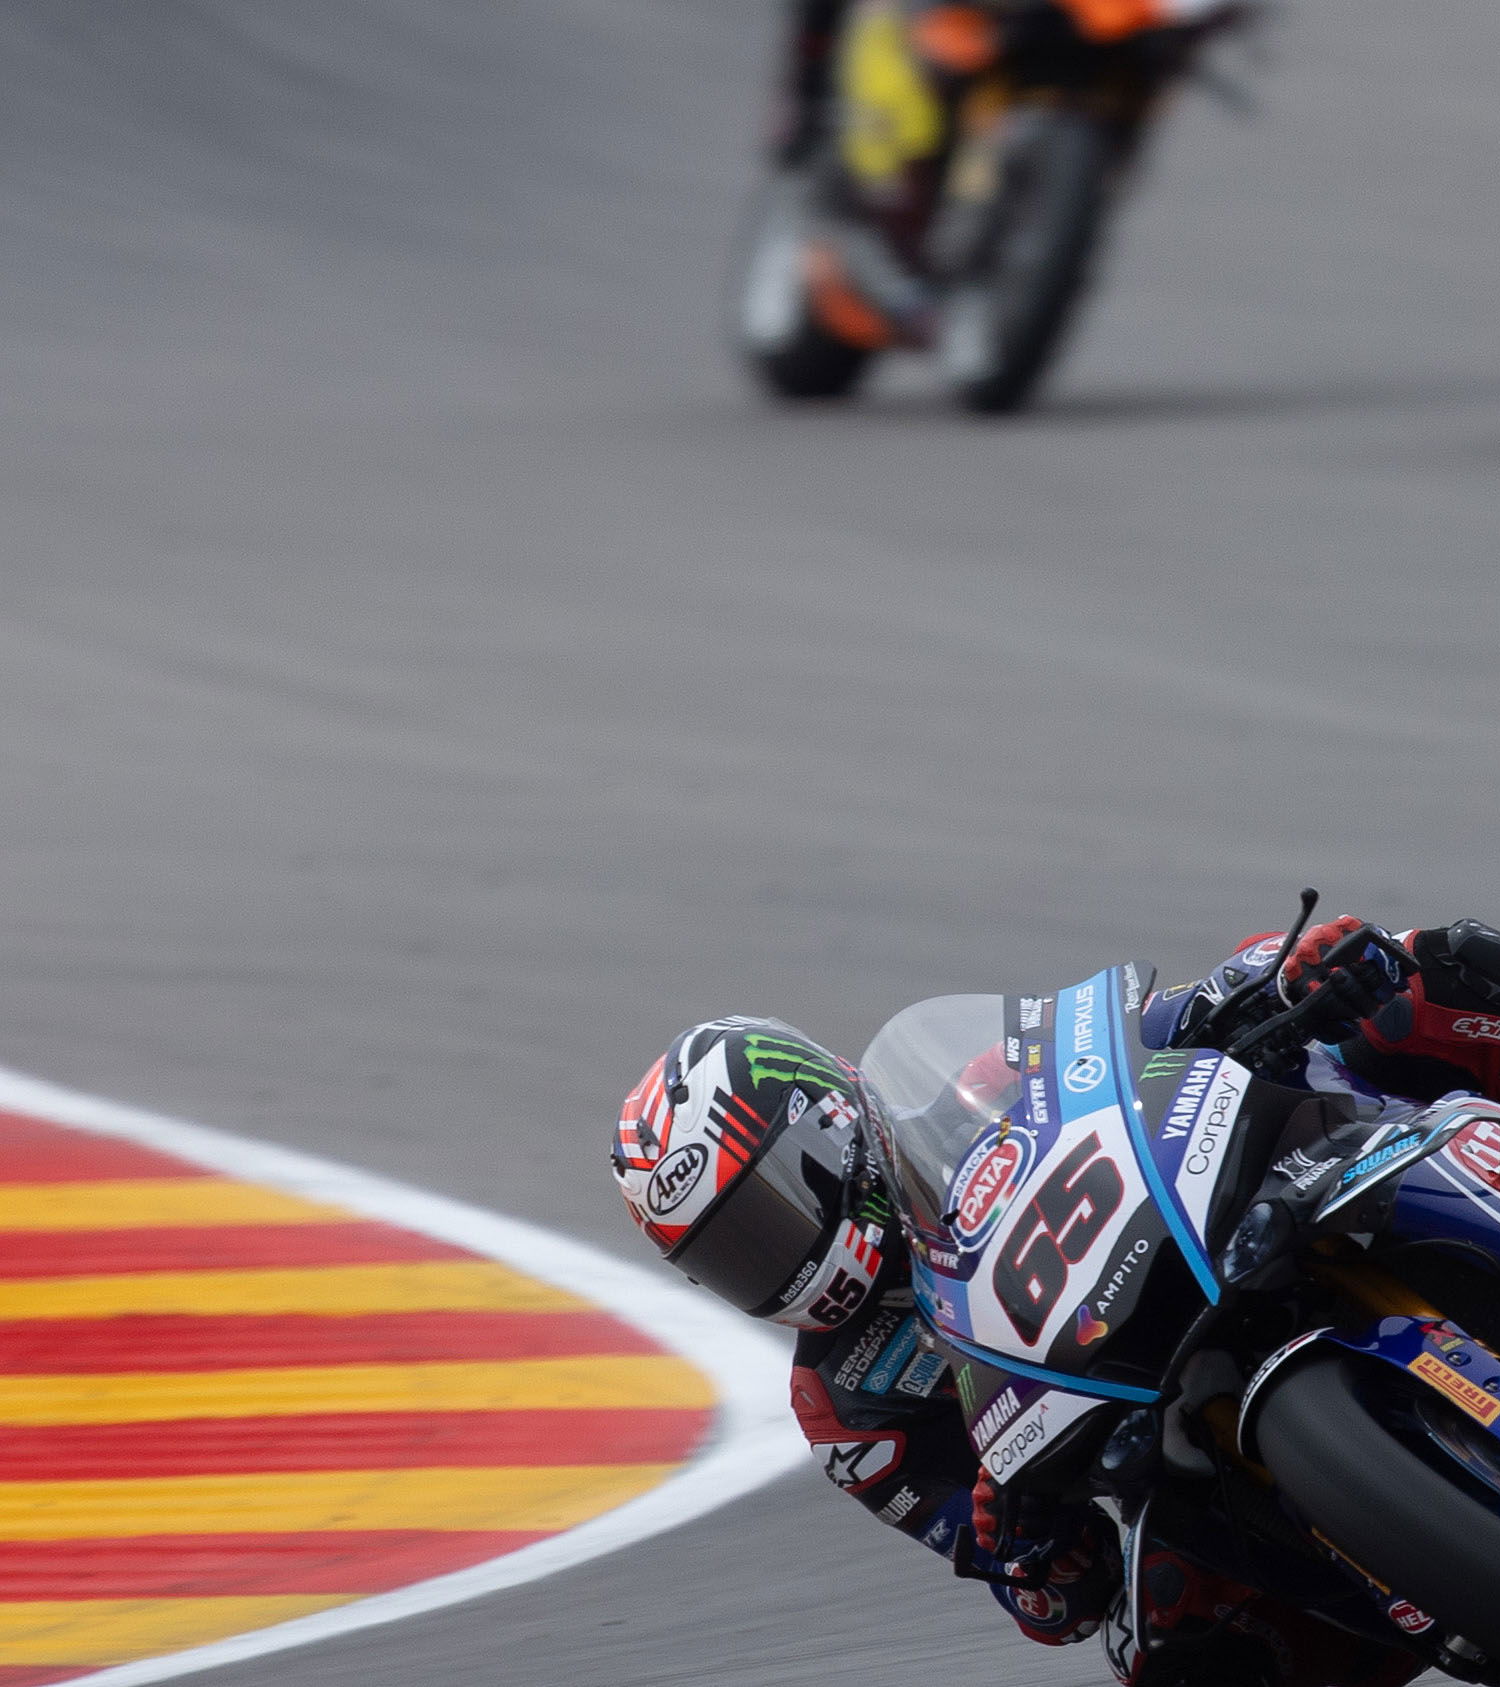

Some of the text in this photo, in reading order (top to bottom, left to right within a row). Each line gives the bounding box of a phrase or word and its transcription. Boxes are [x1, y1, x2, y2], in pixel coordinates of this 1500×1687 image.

[1074, 985, 1094, 1053] MAXUS
[1029, 1077, 1049, 1124] GYTR
[1161, 1057, 1219, 1140] YAMAHA
[1186, 1081, 1240, 1176] Corpay
[652, 1146, 699, 1213] Arai
[954, 1142, 991, 1197] SNACK
[963, 1155, 1014, 1224] PATA
[1342, 1132, 1423, 1185] SQUARE
[992, 1130, 1125, 1348] 65
[780, 1260, 818, 1305] Insta360
[807, 1267, 868, 1327] 65
[1096, 1238, 1150, 1315] AMPITO
[971, 1386, 1022, 1453] YAMAHA
[1416, 1358, 1499, 1421] PIRELLI
[989, 1412, 1046, 1477] Corpay
[1398, 1610, 1429, 1630] HEL
